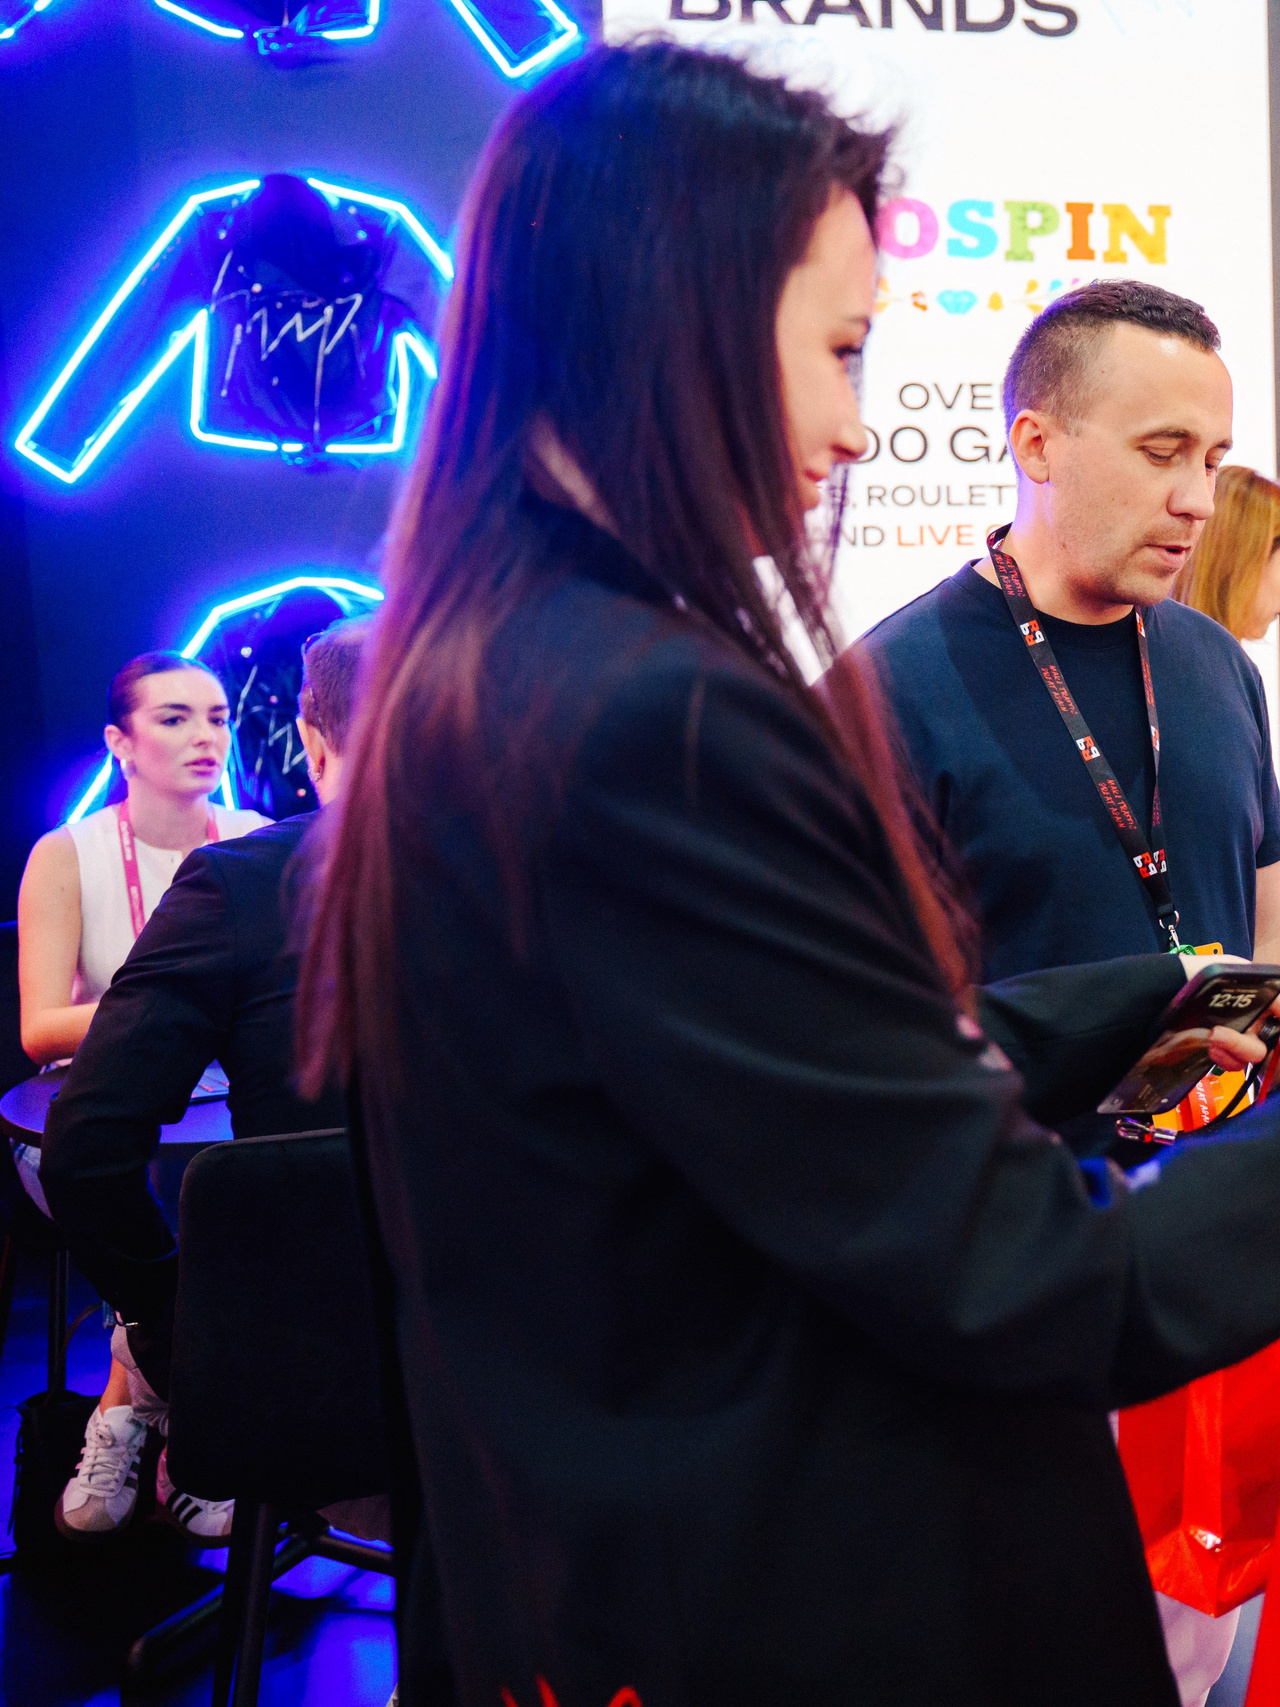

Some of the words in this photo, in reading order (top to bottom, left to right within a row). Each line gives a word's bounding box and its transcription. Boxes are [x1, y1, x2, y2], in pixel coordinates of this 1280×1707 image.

[899, 383, 1003, 410] OVE
[950, 426, 1008, 463] G
[897, 524, 975, 547] LIVE
[1208, 993, 1256, 1008] 12:15
